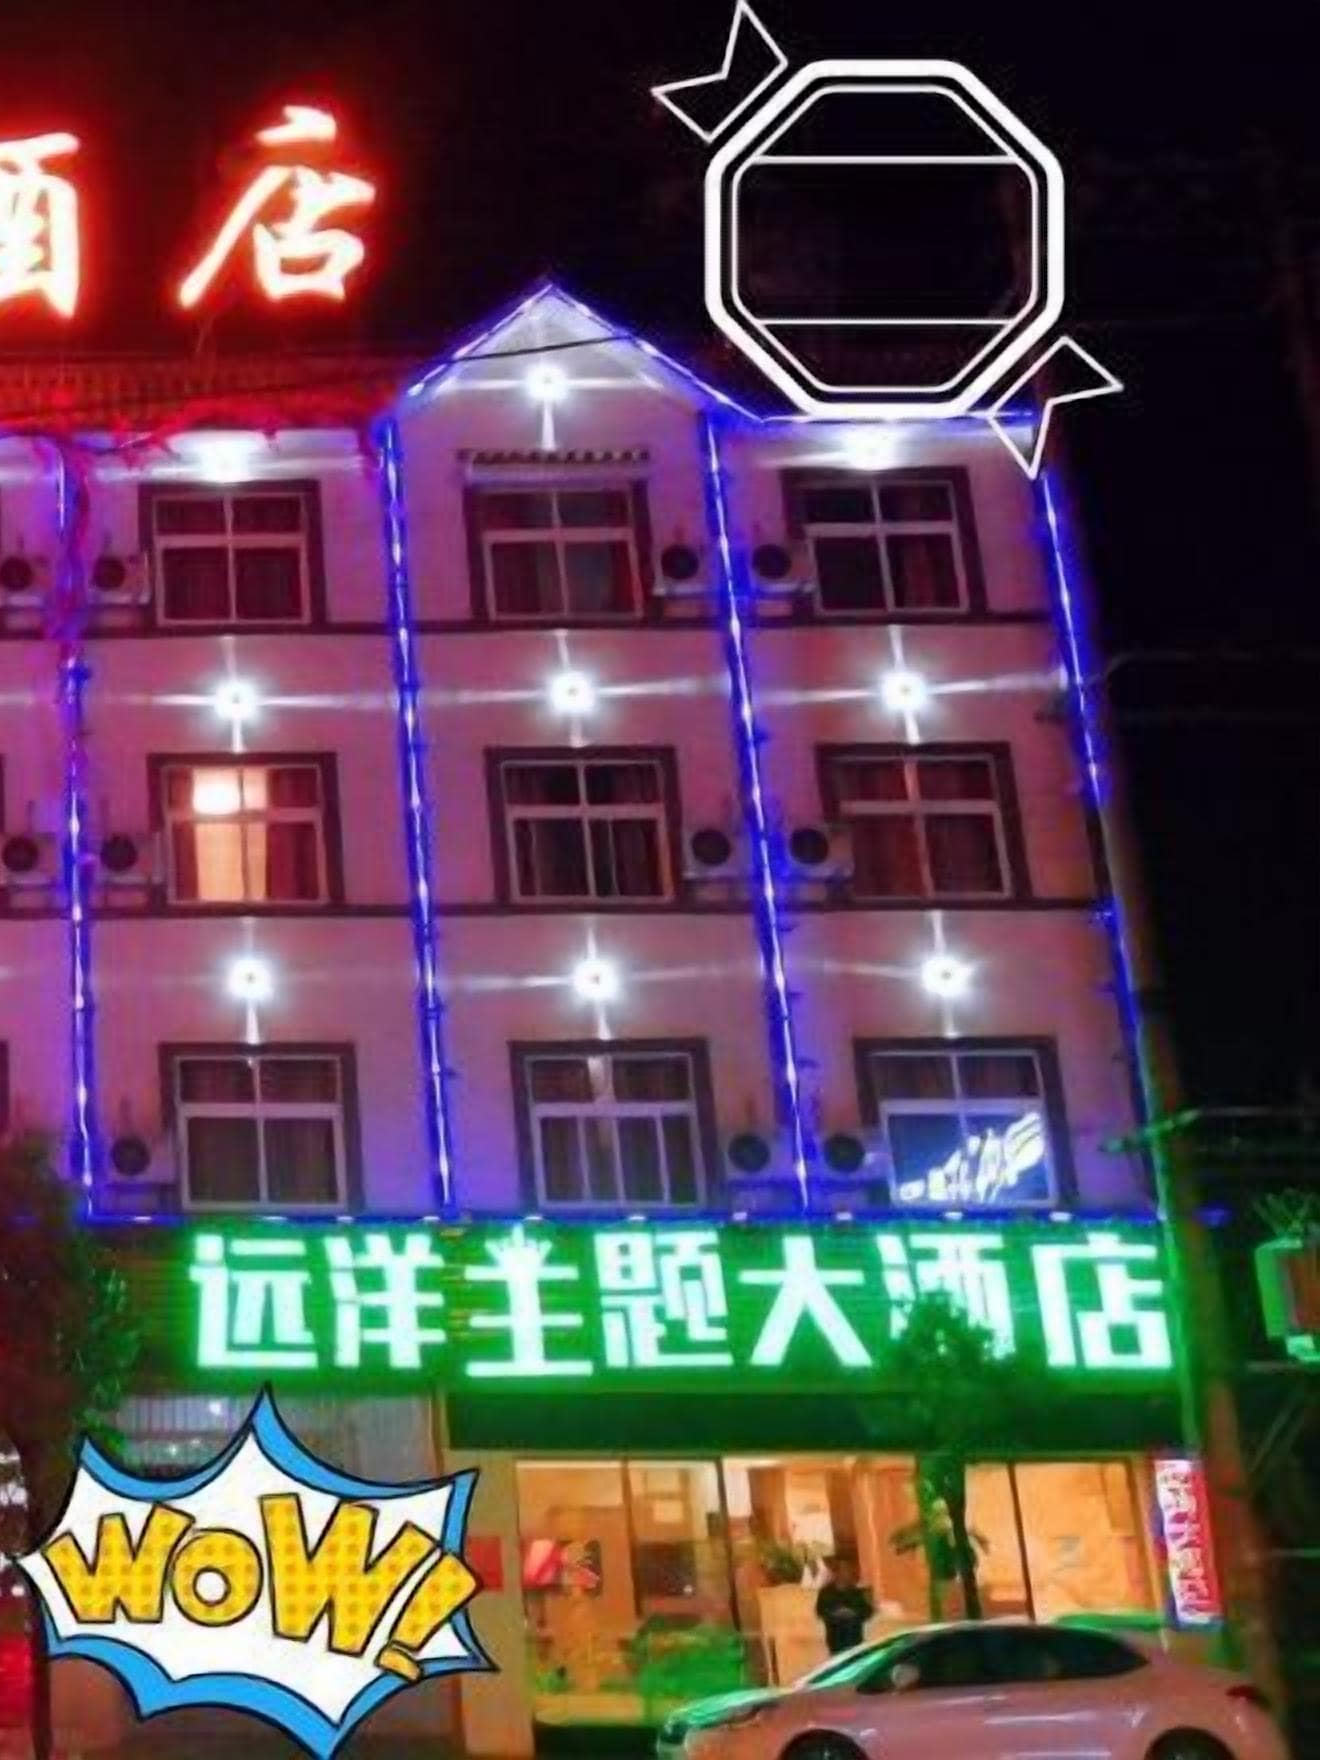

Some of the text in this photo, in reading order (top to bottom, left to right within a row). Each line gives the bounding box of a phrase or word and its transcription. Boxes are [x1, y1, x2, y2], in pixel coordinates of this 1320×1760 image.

[188, 1225, 1173, 1376] 远洋主题大酒店
